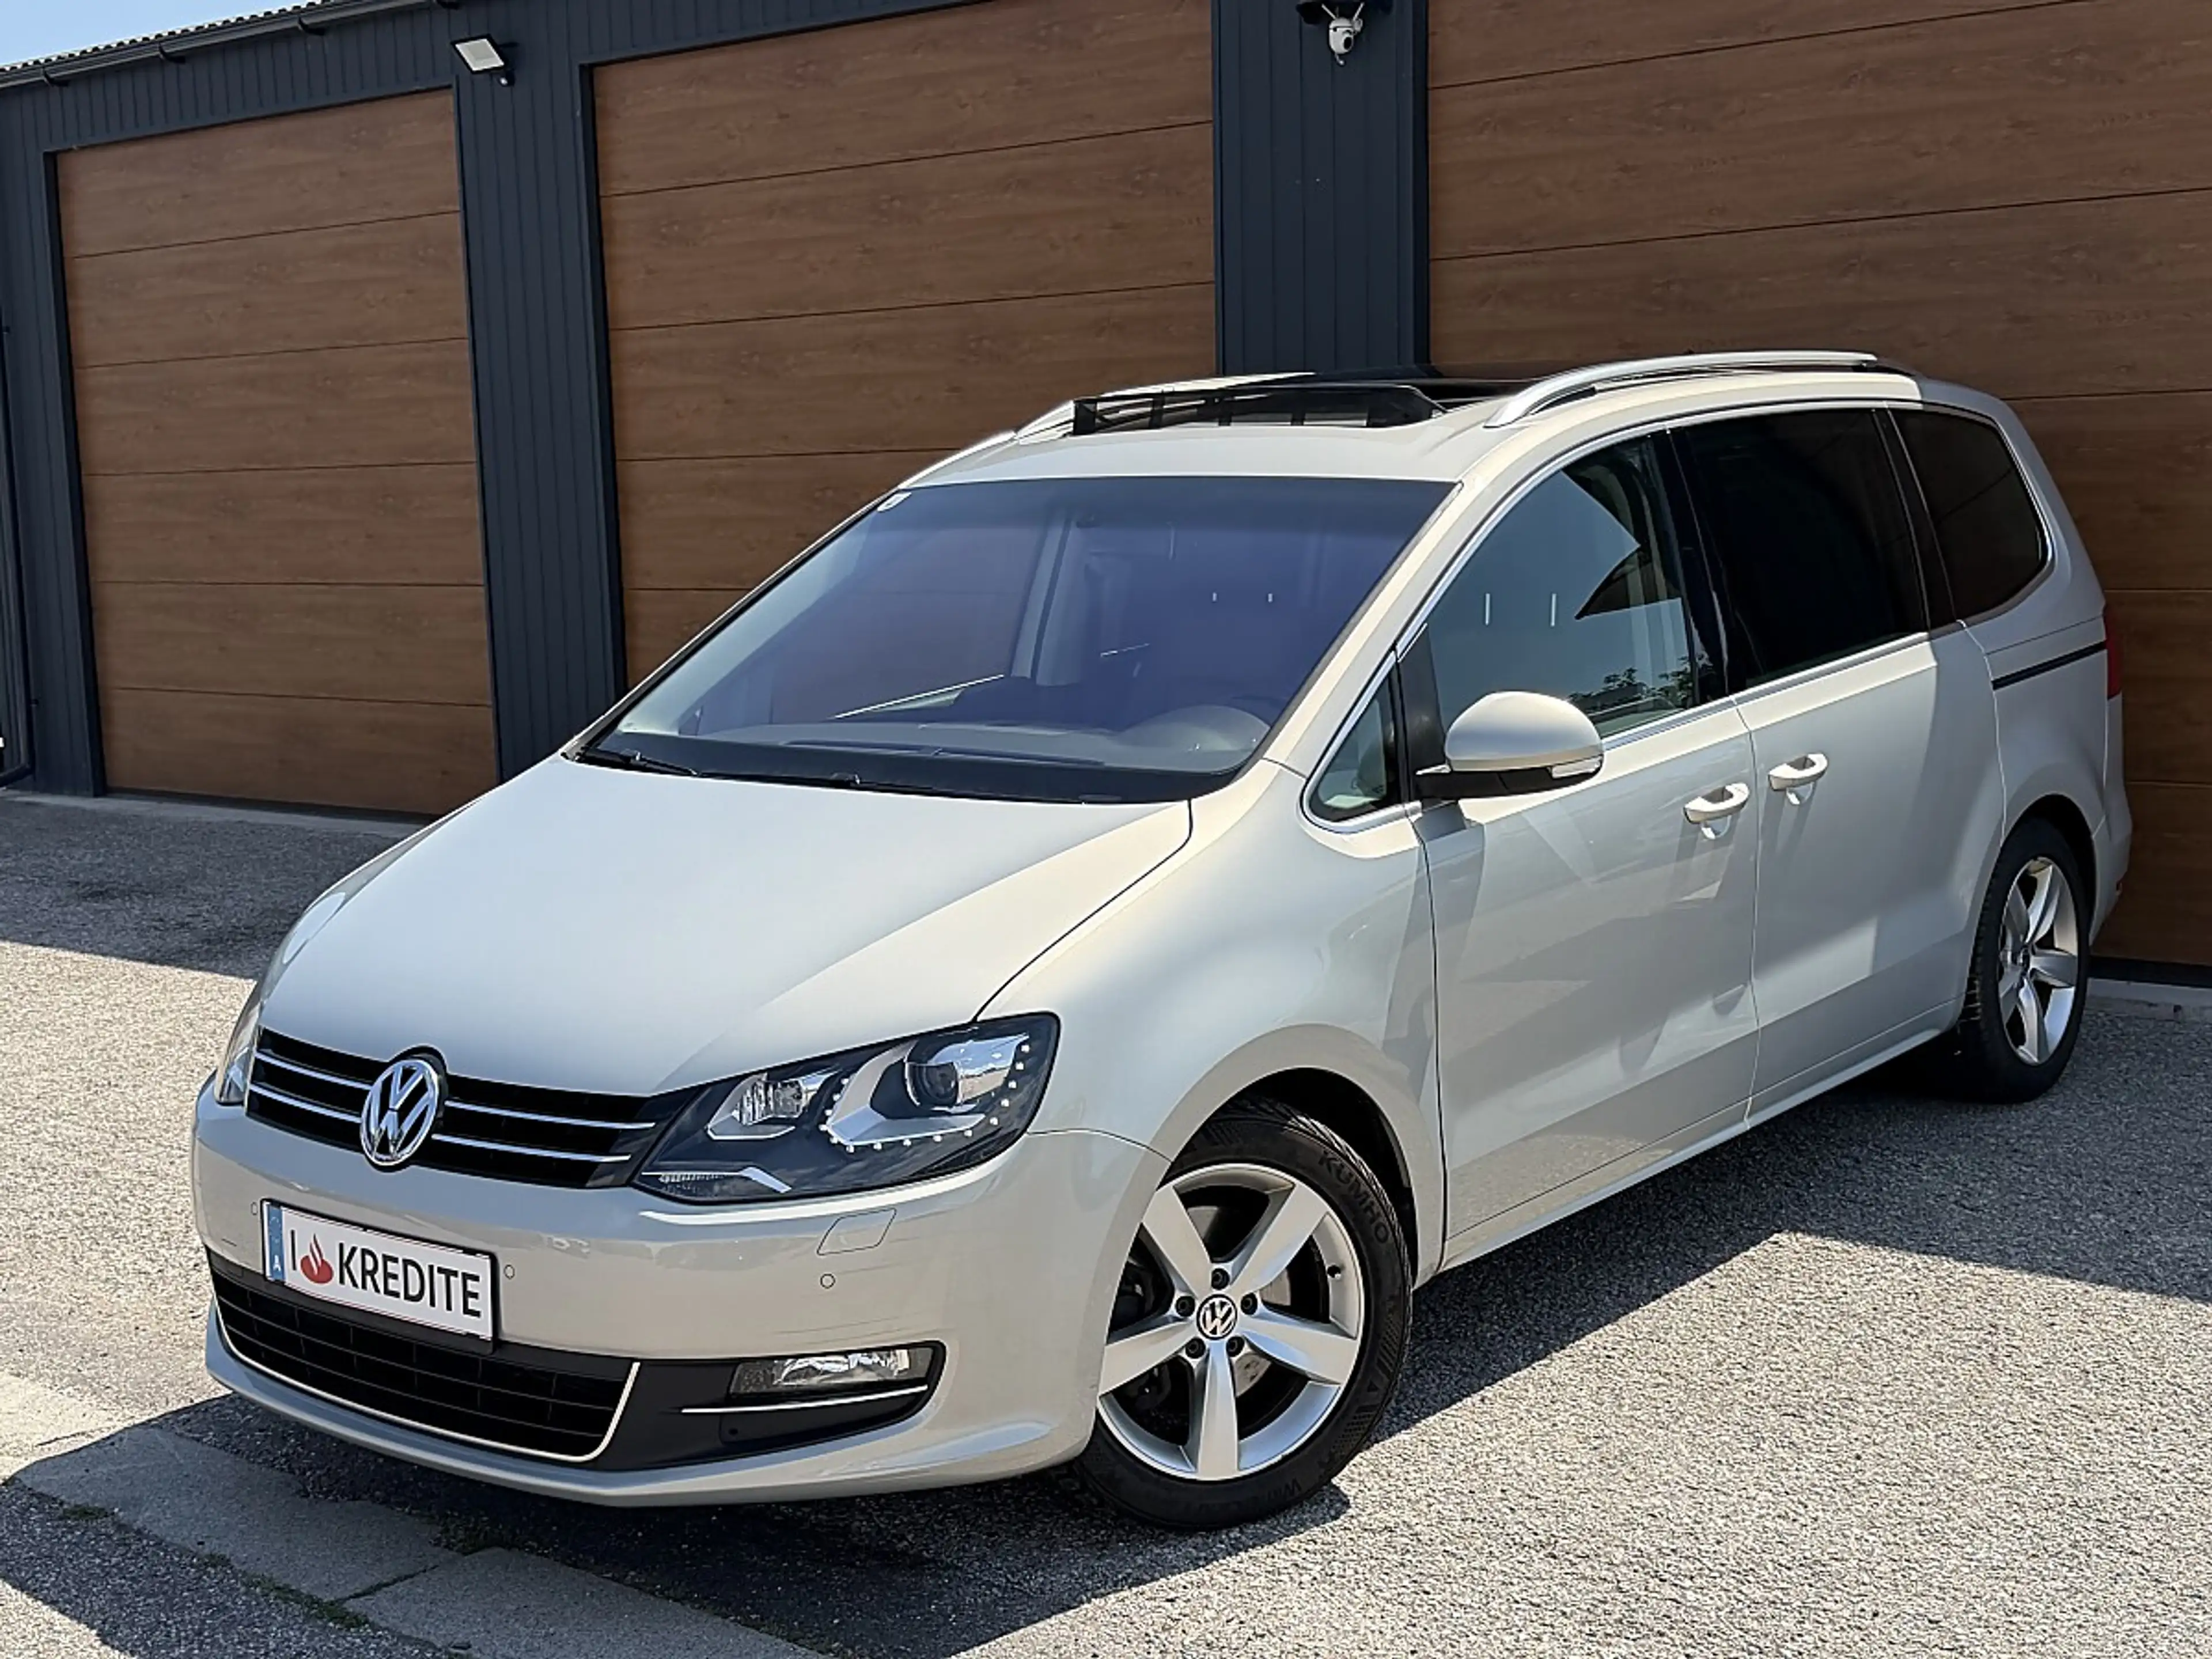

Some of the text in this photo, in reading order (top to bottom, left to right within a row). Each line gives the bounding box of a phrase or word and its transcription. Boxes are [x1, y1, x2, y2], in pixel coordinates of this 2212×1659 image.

[1318, 1152, 1389, 1243] KUMHO
[291, 1229, 481, 1318] I KREDITE
